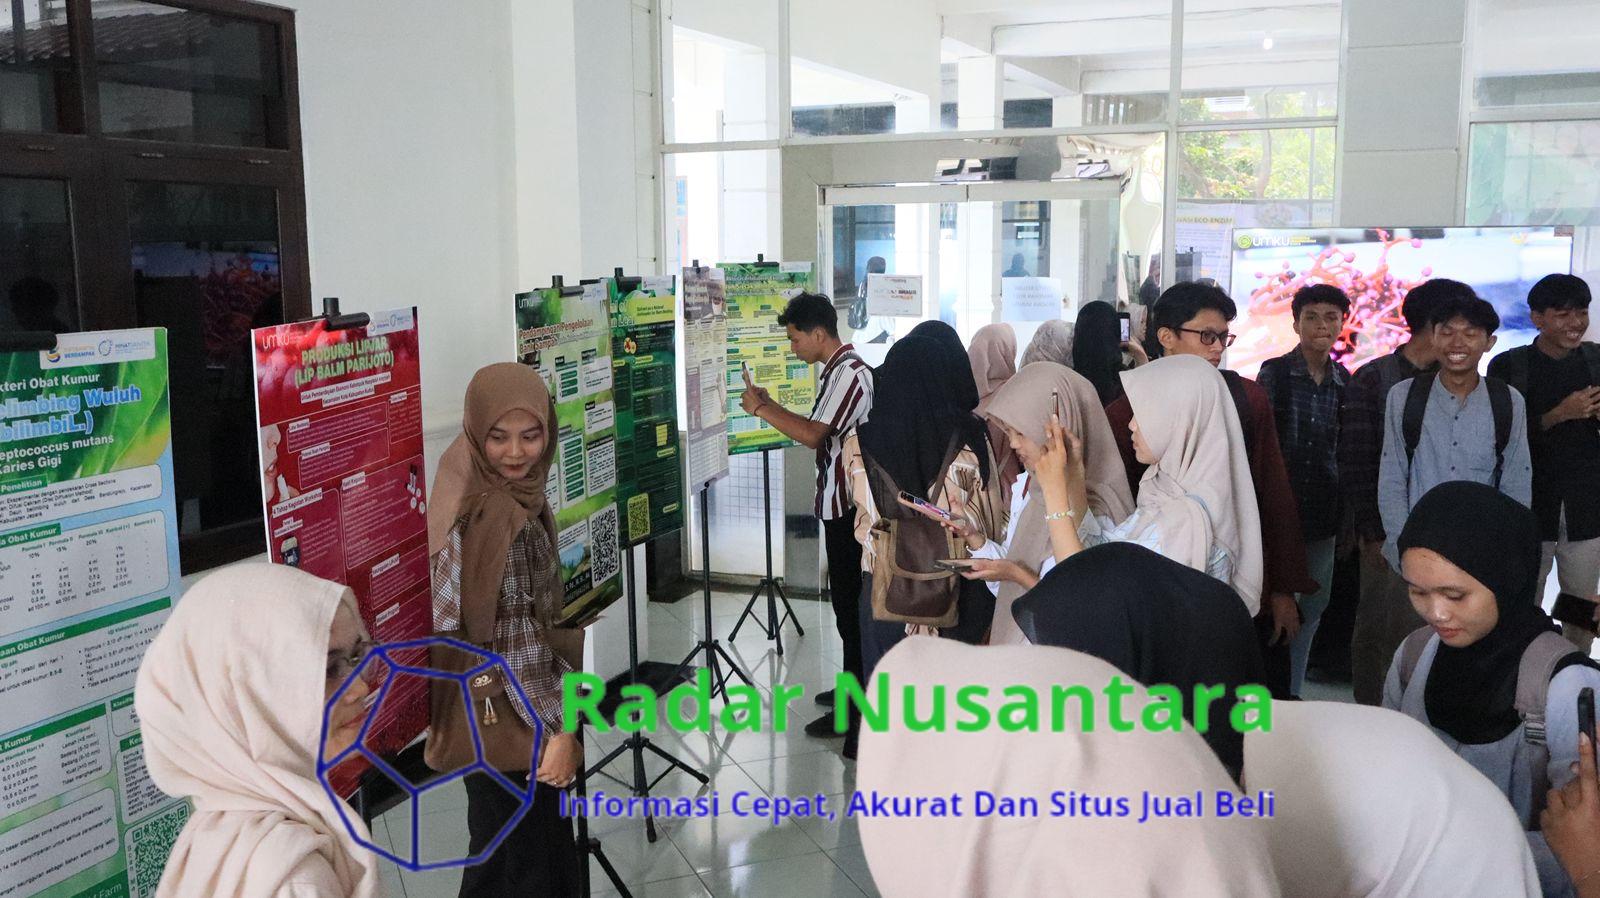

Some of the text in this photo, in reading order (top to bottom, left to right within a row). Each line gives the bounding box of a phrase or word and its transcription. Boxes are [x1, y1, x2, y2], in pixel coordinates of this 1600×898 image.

[1252, 236, 1290, 247] umku
[262, 332, 290, 349] umku
[302, 342, 354, 365] PRODUKSI
[317, 361, 345, 379] BALM
[347, 350, 395, 374] PARIJOTO)
[30, 378, 59, 389] Obat
[62, 374, 100, 385] Kumur
[83, 384, 142, 408] Wuluh
[72, 434, 114, 449] mutans
[38, 454, 62, 468] Gigi
[1, 480, 42, 493] Penelitian
[8, 527, 57, 544] Obat Kumur
[17, 632, 66, 651] Obat Kumur
[4, 734, 33, 750] Kumur
